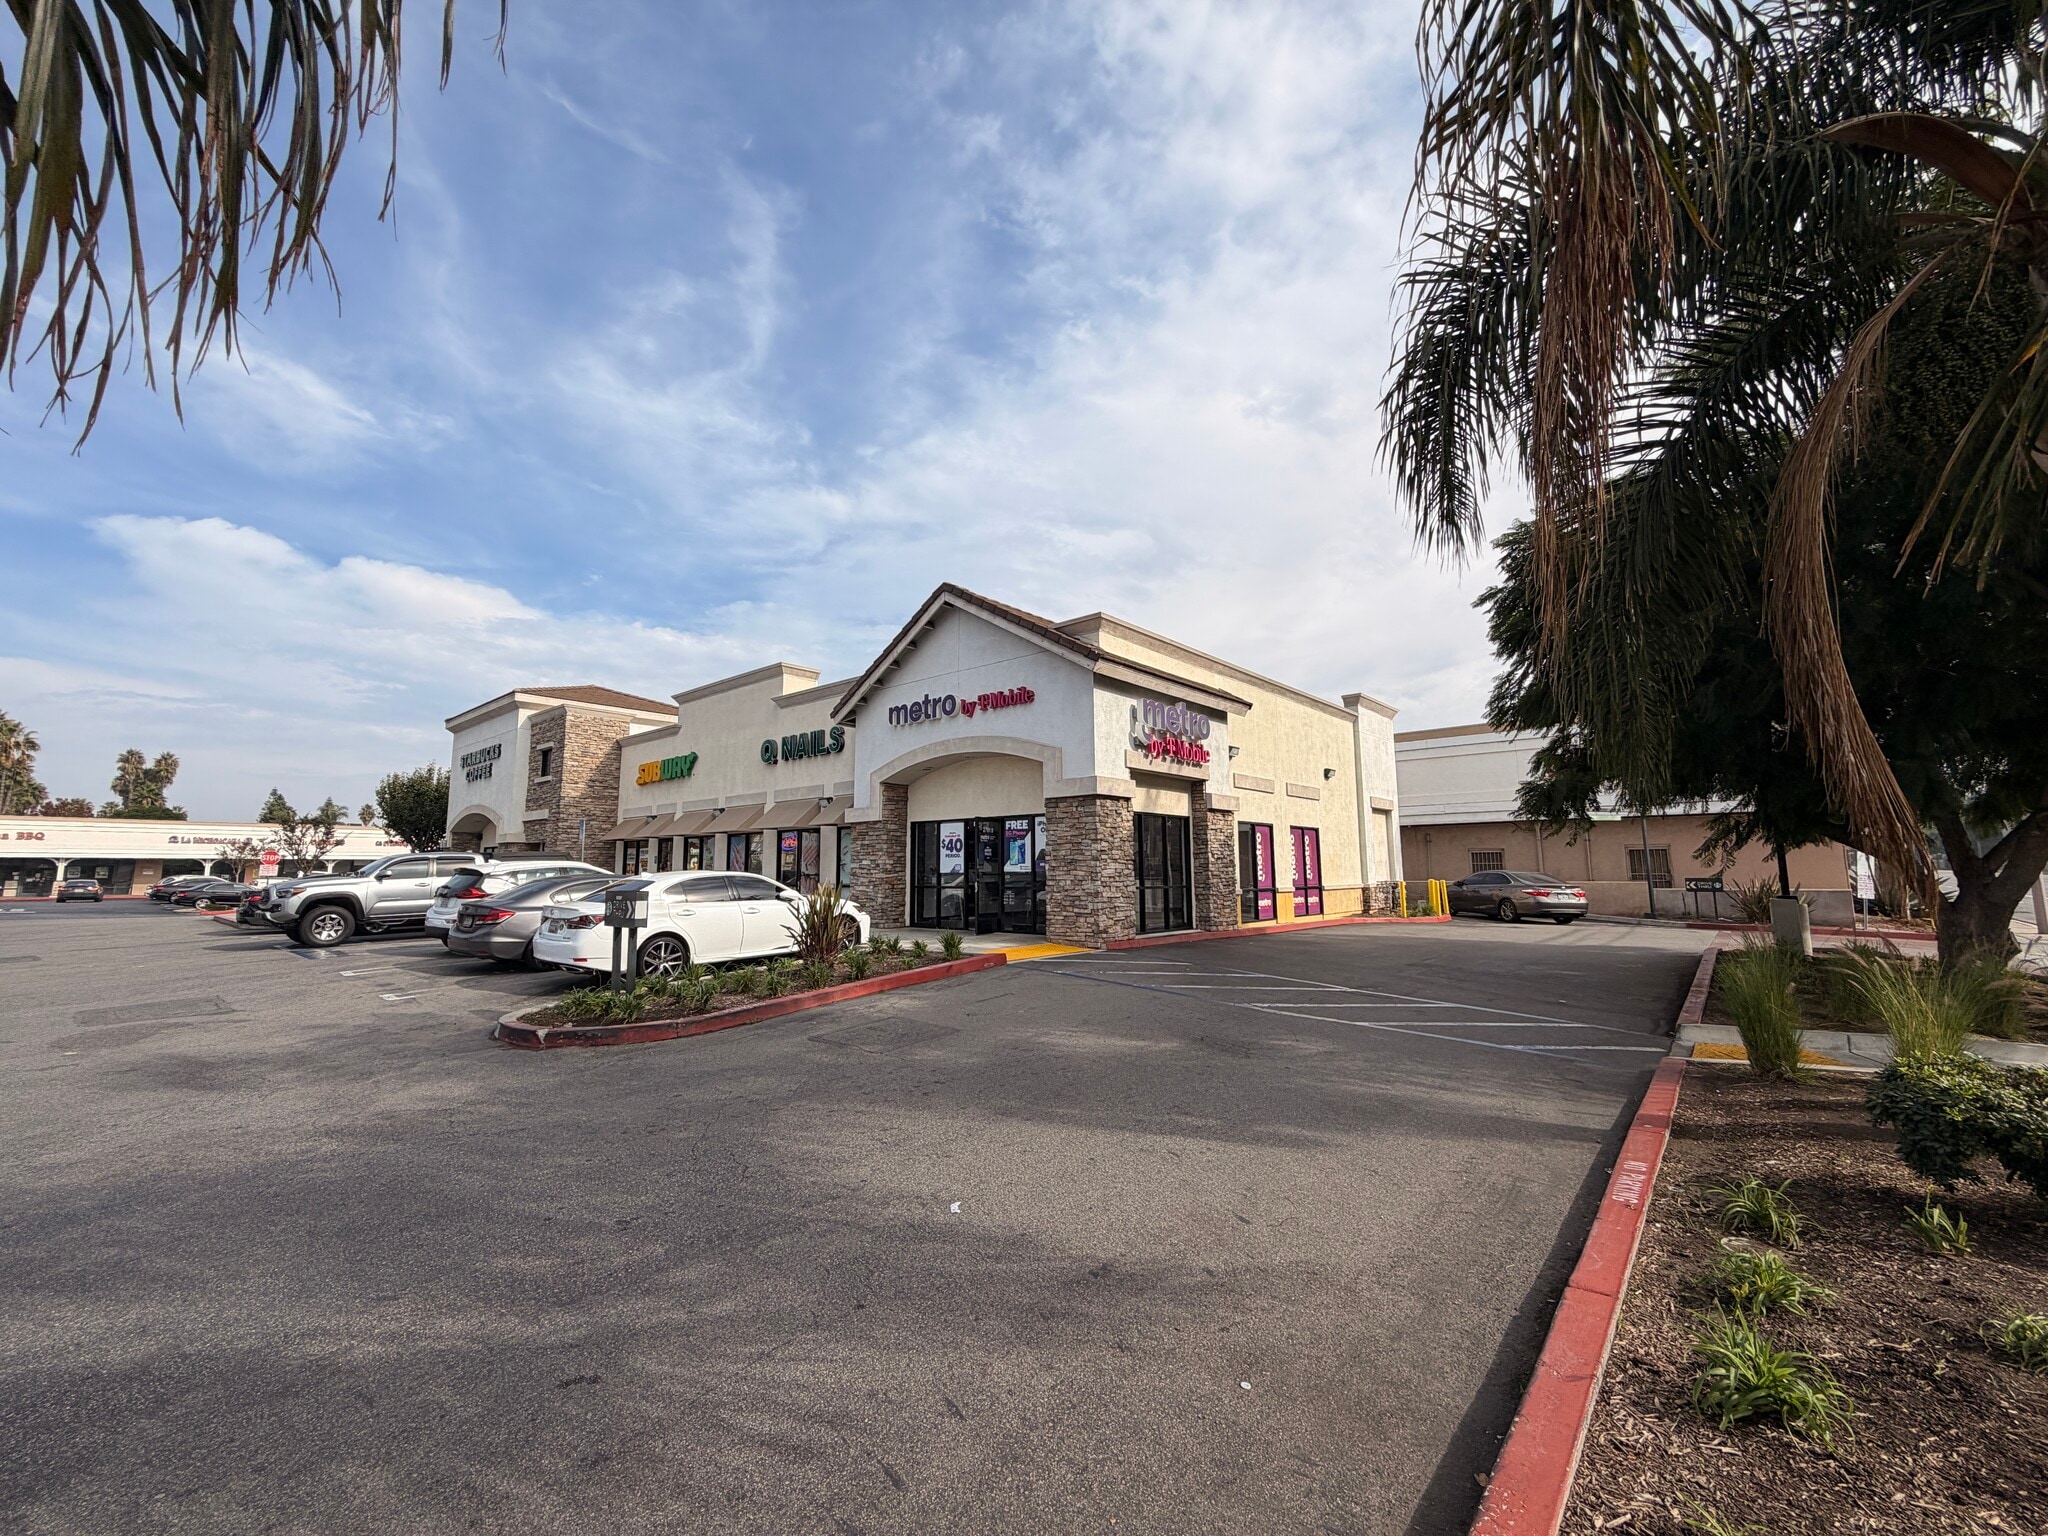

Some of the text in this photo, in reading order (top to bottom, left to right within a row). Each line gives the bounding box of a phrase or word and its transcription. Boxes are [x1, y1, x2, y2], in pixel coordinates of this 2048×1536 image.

[888, 693, 957, 727] metro
[960, 699, 977, 718] by
[1139, 698, 1211, 742] metro
[460, 743, 502, 769] STARBUCKS
[760, 725, 846, 765] Q NAILS
[1149, 738, 1165, 760] by
[465, 762, 493, 783] COFFEE
[635, 751, 699, 786] SUBWAY
[15, 831, 46, 841] BBQ
[1005, 820, 1029, 829] FREE
[941, 837, 963, 853] $40
[1256, 832, 1265, 882] metro
[1304, 835, 1313, 880] metro
